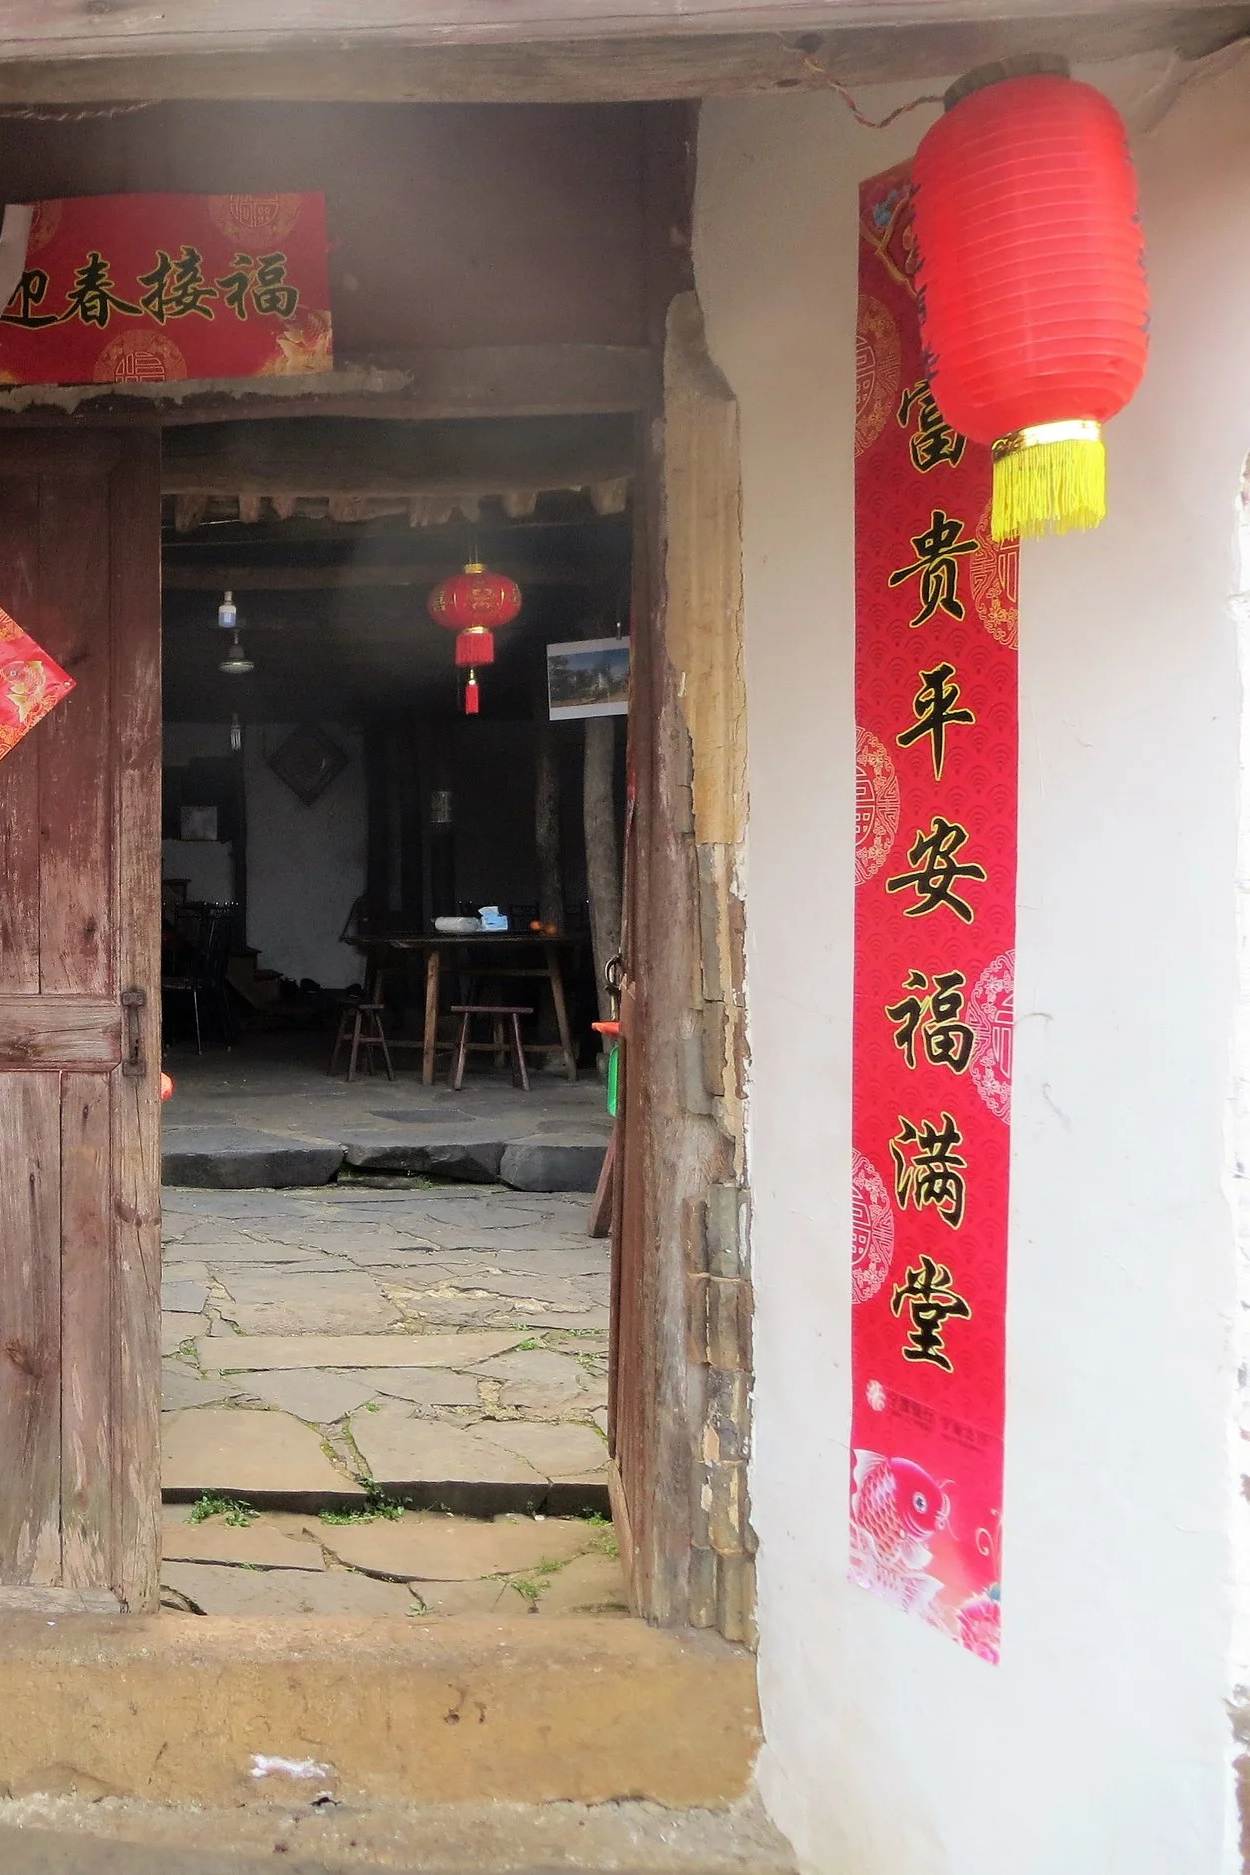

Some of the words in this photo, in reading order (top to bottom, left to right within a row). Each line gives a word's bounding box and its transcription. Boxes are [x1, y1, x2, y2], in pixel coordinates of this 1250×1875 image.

[887, 379, 988, 1374] 富贵平安福满堂
